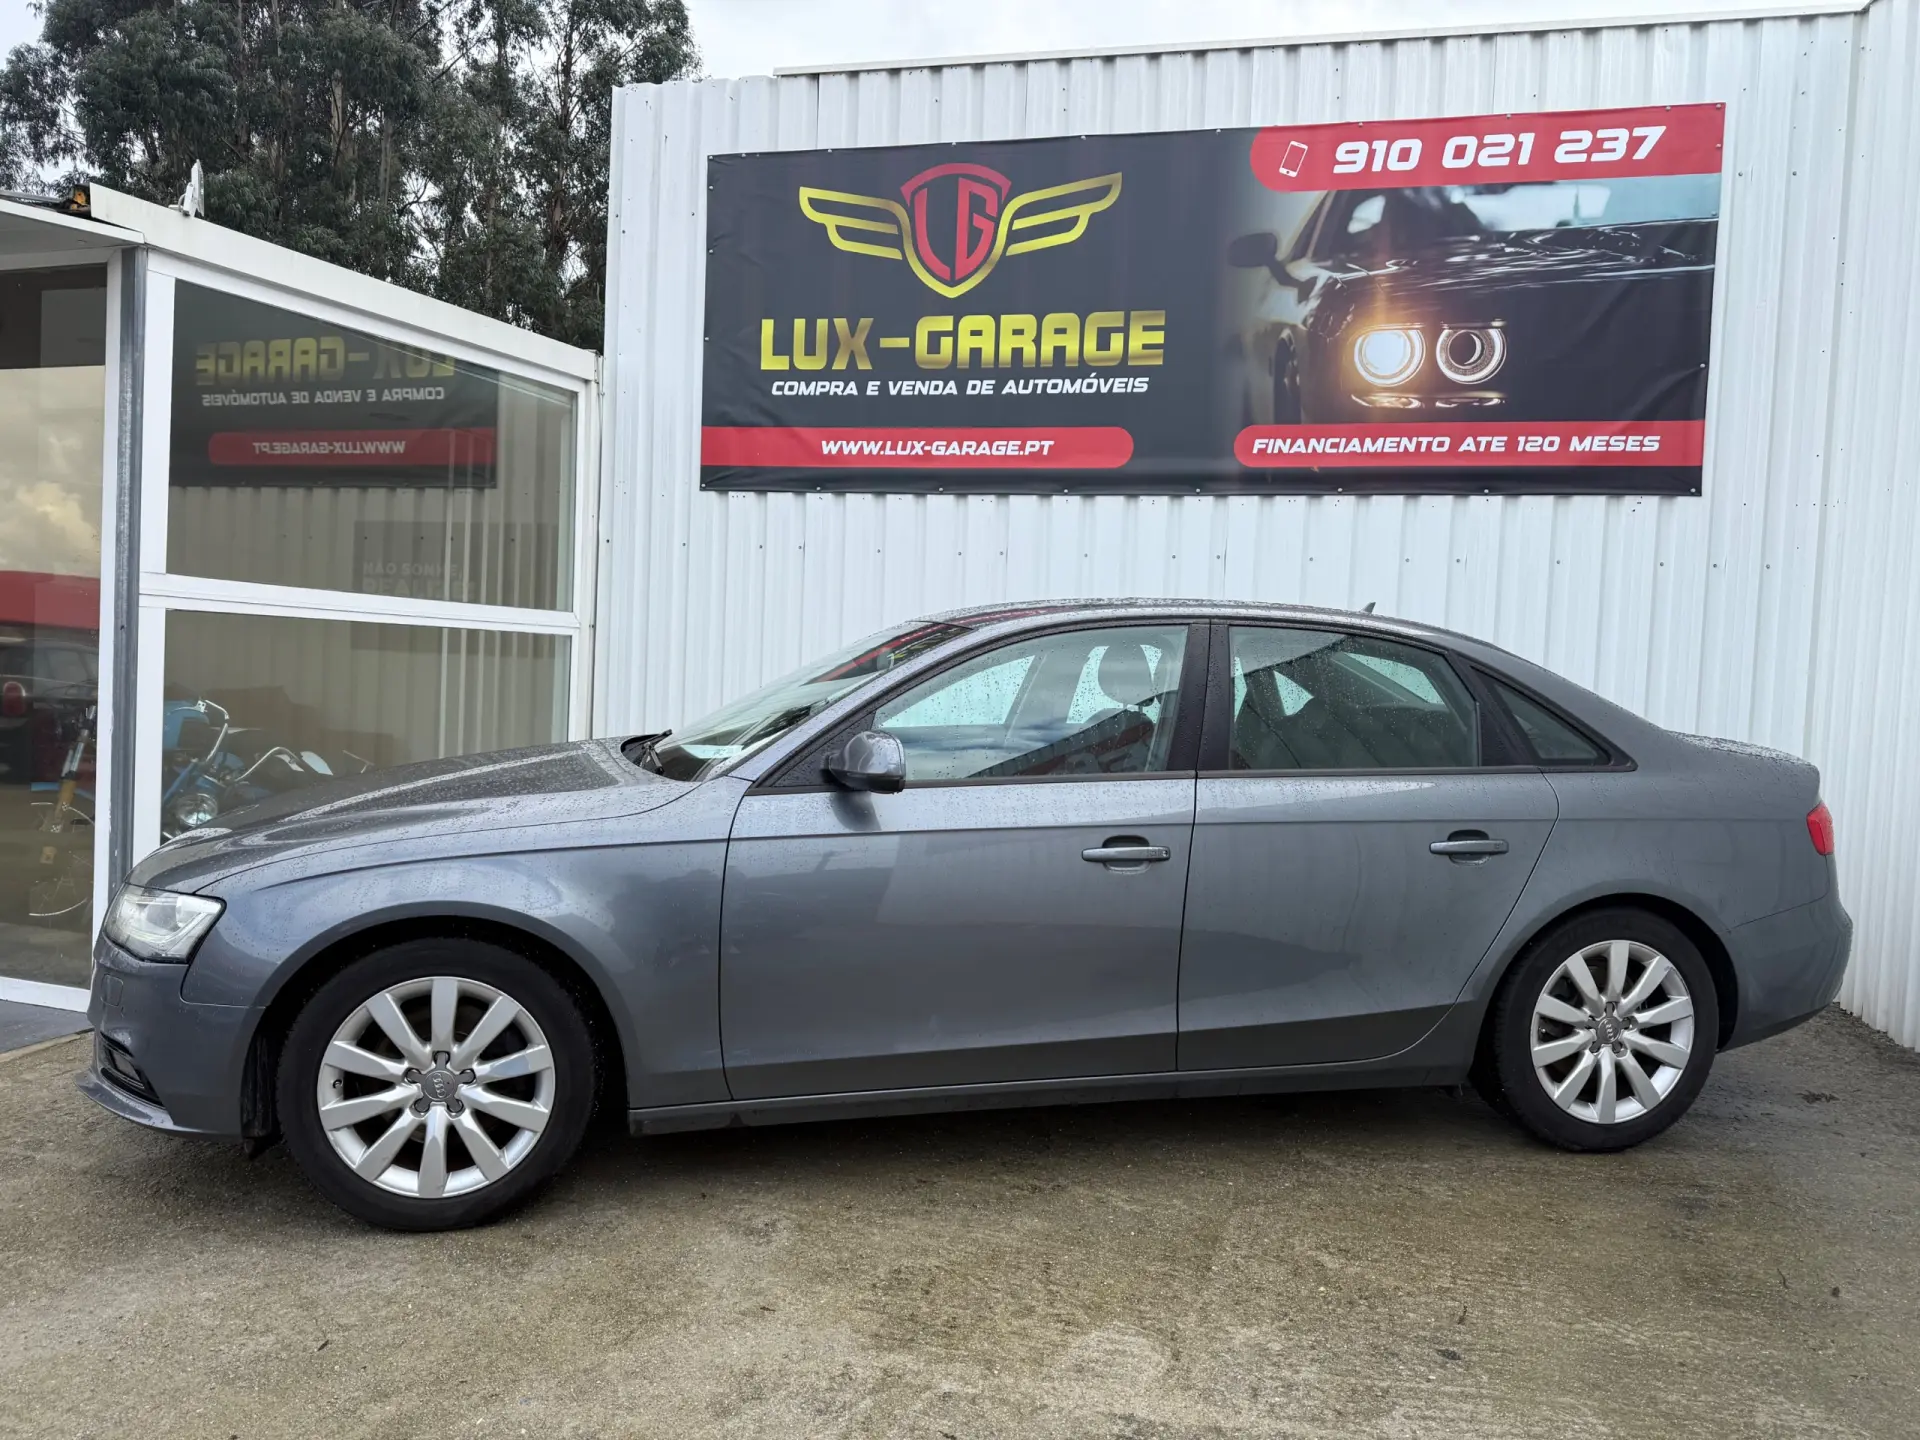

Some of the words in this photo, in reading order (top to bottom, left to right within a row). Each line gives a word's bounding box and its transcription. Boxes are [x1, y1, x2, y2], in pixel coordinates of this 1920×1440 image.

[1332, 139, 1423, 174] 910
[1441, 132, 1537, 169] 021
[1553, 125, 1667, 164] 237
[760, 309, 1167, 371] LUX-GARAGE
[771, 379, 858, 396] COMPRA
[866, 379, 880, 396] E
[888, 379, 958, 396] VENDA
[966, 378, 996, 396] DE
[1002, 371, 1150, 395] AUTOMÓVEIS
[821, 439, 1055, 457] WWW.LUX-GARAGE.PT
[1252, 436, 1451, 454] FINANCIAMENTO
[1458, 436, 1508, 453] ATE
[1517, 435, 1561, 452] 120
[1569, 435, 1661, 453] MESES
